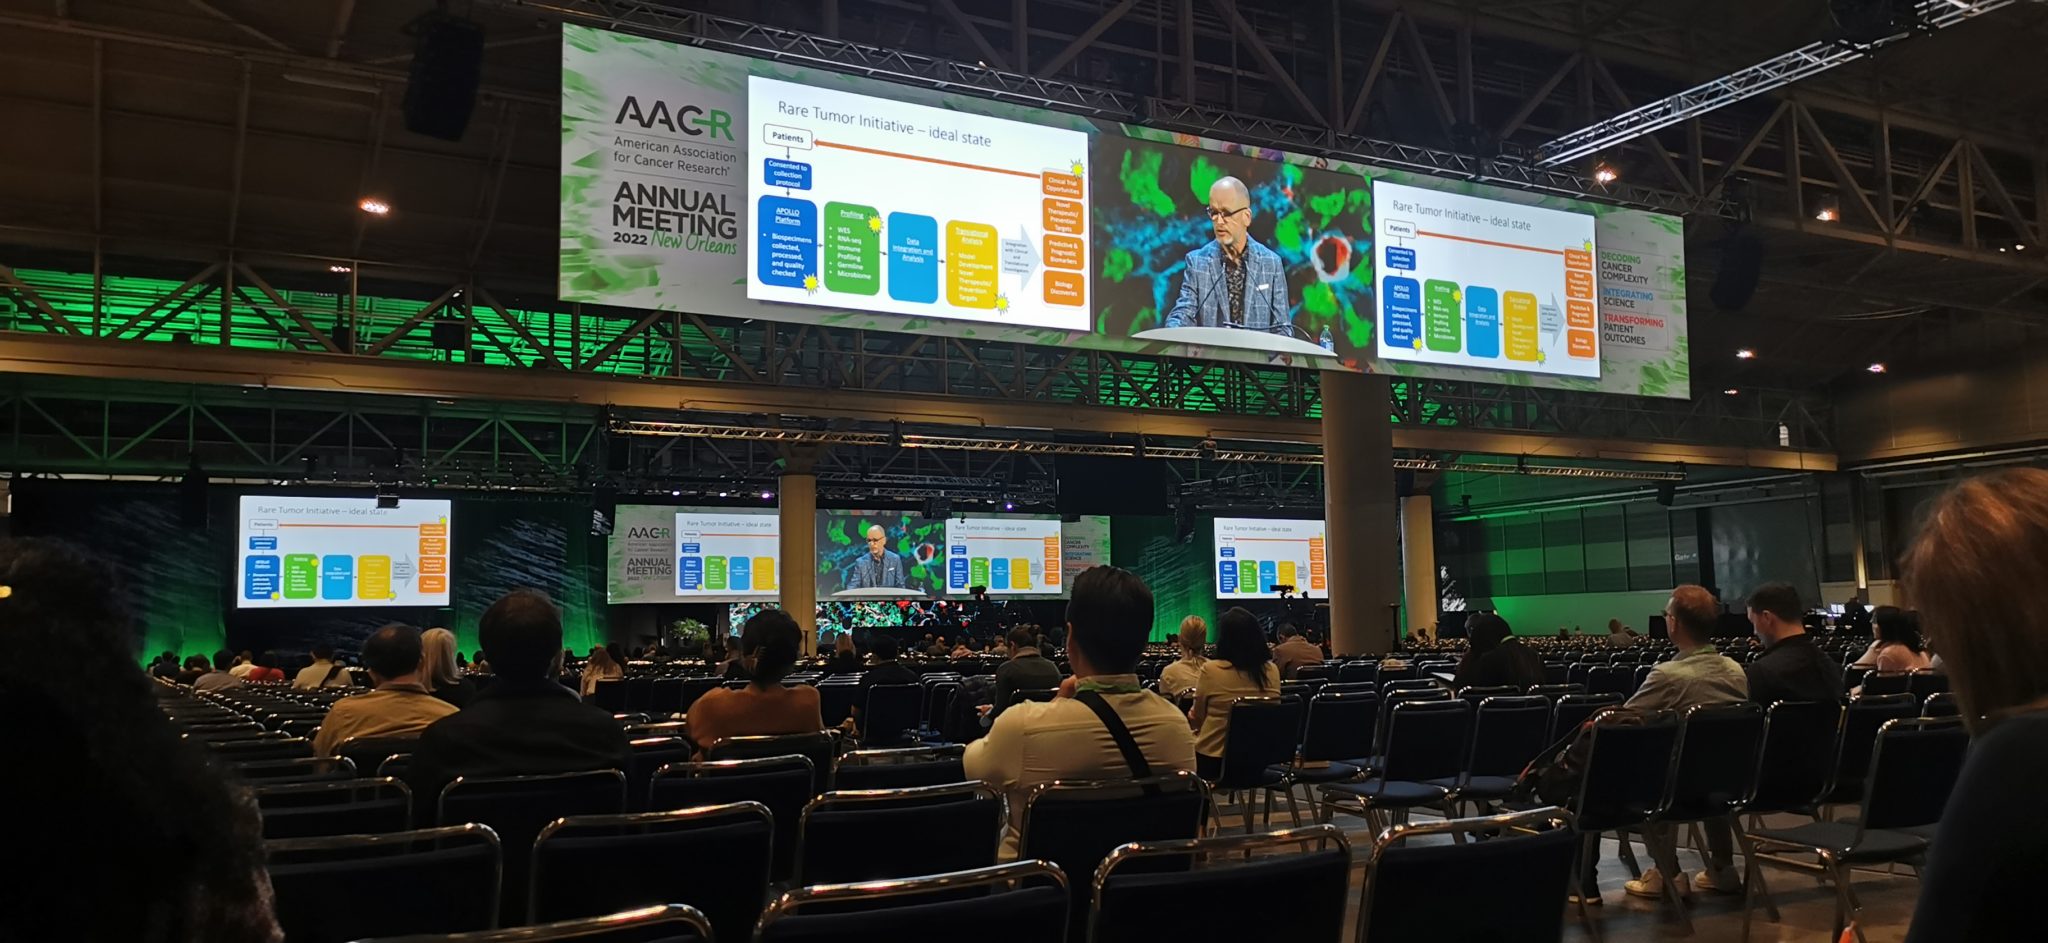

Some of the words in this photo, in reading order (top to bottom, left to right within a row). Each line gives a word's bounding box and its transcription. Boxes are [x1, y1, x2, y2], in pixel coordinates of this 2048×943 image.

[615, 95, 735, 141] AACR
[778, 100, 809, 117] Rare
[813, 106, 855, 124] Tumor
[859, 114, 914, 135] Initiative
[929, 125, 958, 142] ideal
[962, 133, 992, 147] state
[772, 131, 804, 143] Patients
[614, 136, 669, 153] American
[673, 144, 737, 162] Association
[614, 151, 630, 162] for
[634, 154, 674, 169] Cancer
[768, 160, 800, 170] Consented
[773, 170, 803, 179] collection
[775, 180, 801, 188] protocol
[613, 181, 736, 217] ANNUAL
[775, 207, 800, 217] APOLLO
[1393, 200, 1413, 213] Rare
[1415, 203, 1443, 217] Tumor
[1444, 208, 1481, 224] Initiative
[1490, 215, 1510, 228] ideal
[1511, 220, 1532, 231] state
[613, 204, 737, 239] MEETING
[775, 215, 801, 226] Platform
[1389, 225, 1411, 233] Patients
[613, 232, 648, 245] 2022
[651, 230, 682, 248] New
[686, 232, 737, 255] Orleans
[771, 232, 812, 244] Biospecimens
[1601, 251, 1641, 264] DECODING
[784, 262, 805, 270] quality
[1601, 261, 1633, 273] CANCER
[771, 269, 797, 277] checked
[1601, 271, 1649, 284] COMPLEXITY
[1603, 287, 1654, 301] INTEGRATING
[1603, 297, 1635, 308] SCIENCE
[1603, 313, 1664, 328] TRANSFORMING
[1604, 323, 1634, 333] PATIENT
[1604, 333, 1646, 345] OUTCOMES
[257, 505, 277, 514] Rare
[279, 506, 305, 514] Tumor
[306, 507, 341, 515] Initiative
[349, 507, 368, 515] ideal
[628, 527, 670, 539] AACR
[627, 558, 672, 567] ANNUAL
[626, 566, 673, 575] MEETING
